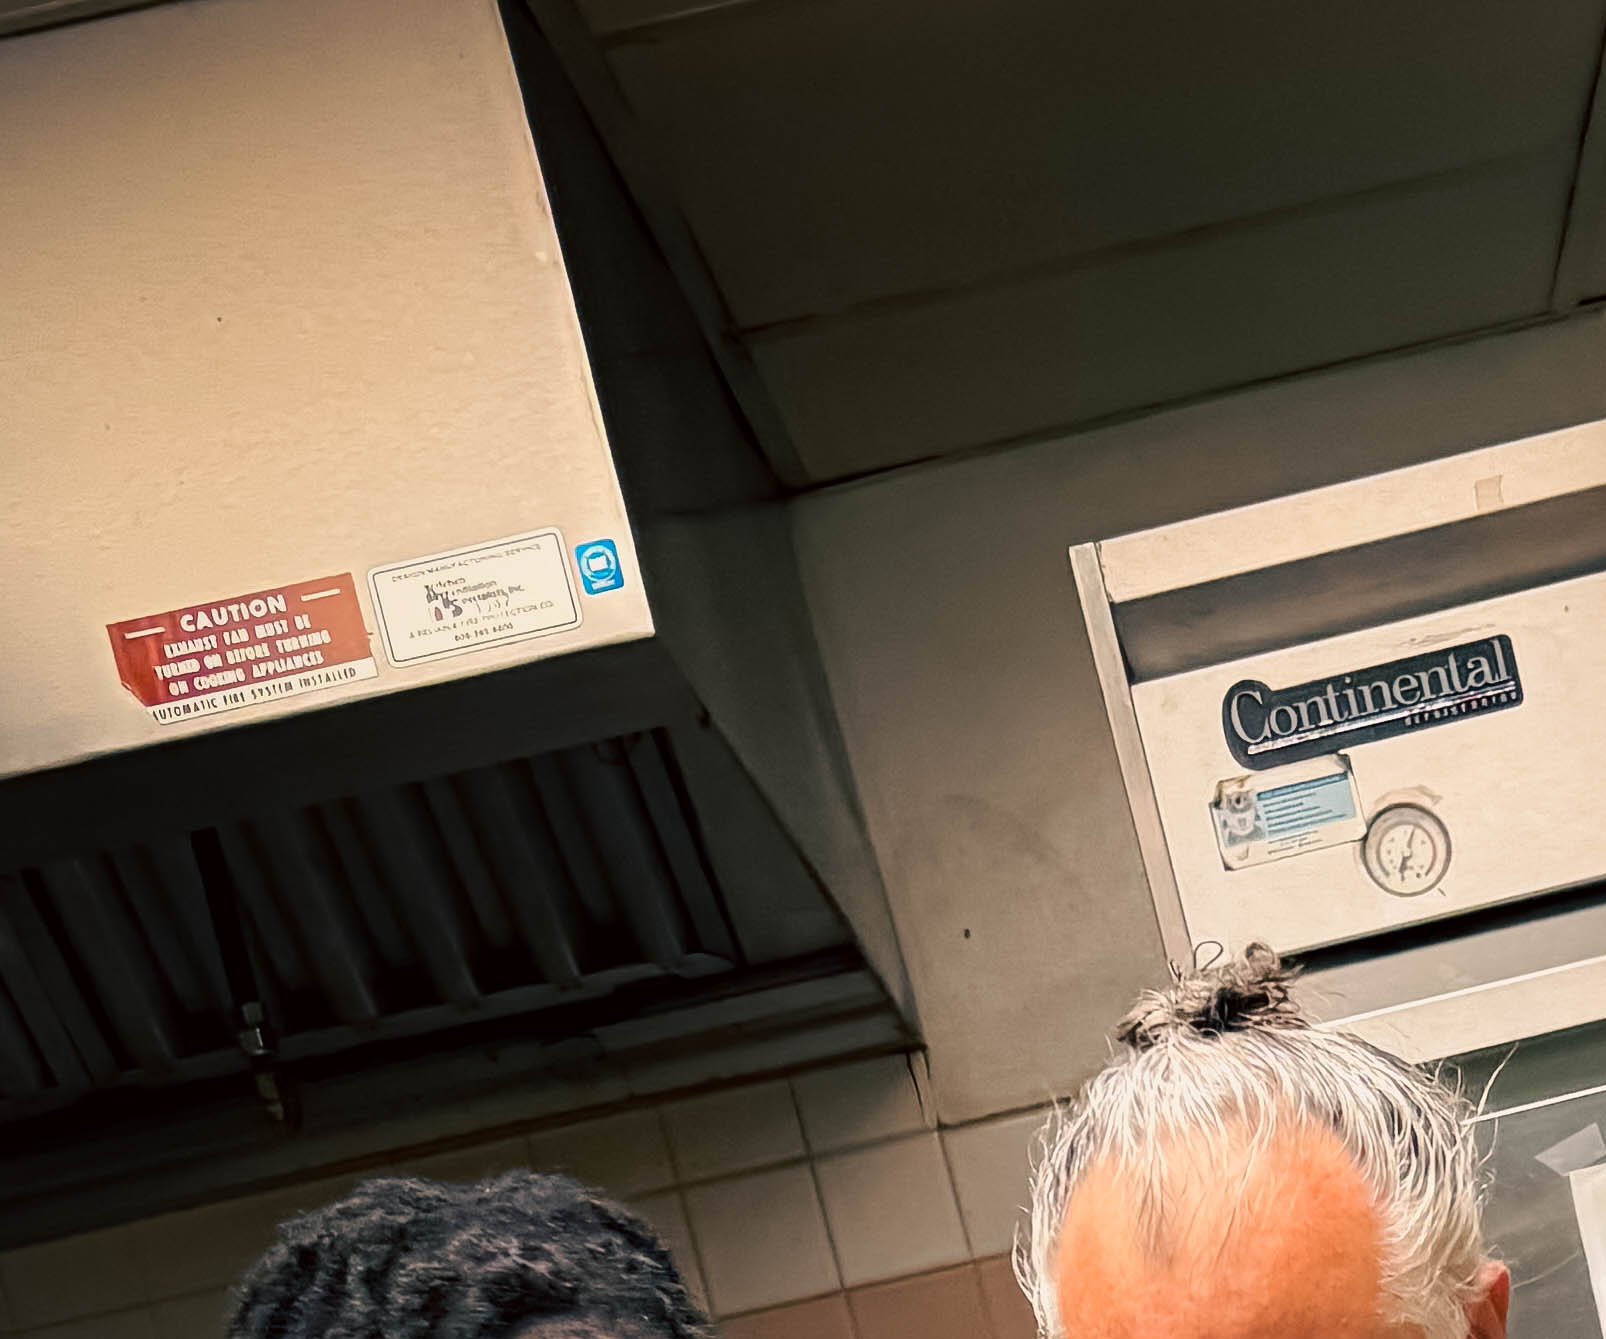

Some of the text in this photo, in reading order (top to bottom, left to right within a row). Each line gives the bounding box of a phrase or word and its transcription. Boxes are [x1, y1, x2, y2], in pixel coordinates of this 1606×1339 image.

[180, 594, 286, 632] CAUTION
[154, 630, 331, 680] TURNED ON BEFORE TURNING
[164, 615, 311, 658] EXHAUST FAN MUST BE
[169, 650, 324, 695] ON COOKING APPLIANCES
[251, 682, 293, 699] SYSTEM
[299, 668, 356, 688] INSTALLED
[1231, 638, 1512, 746] Continental
